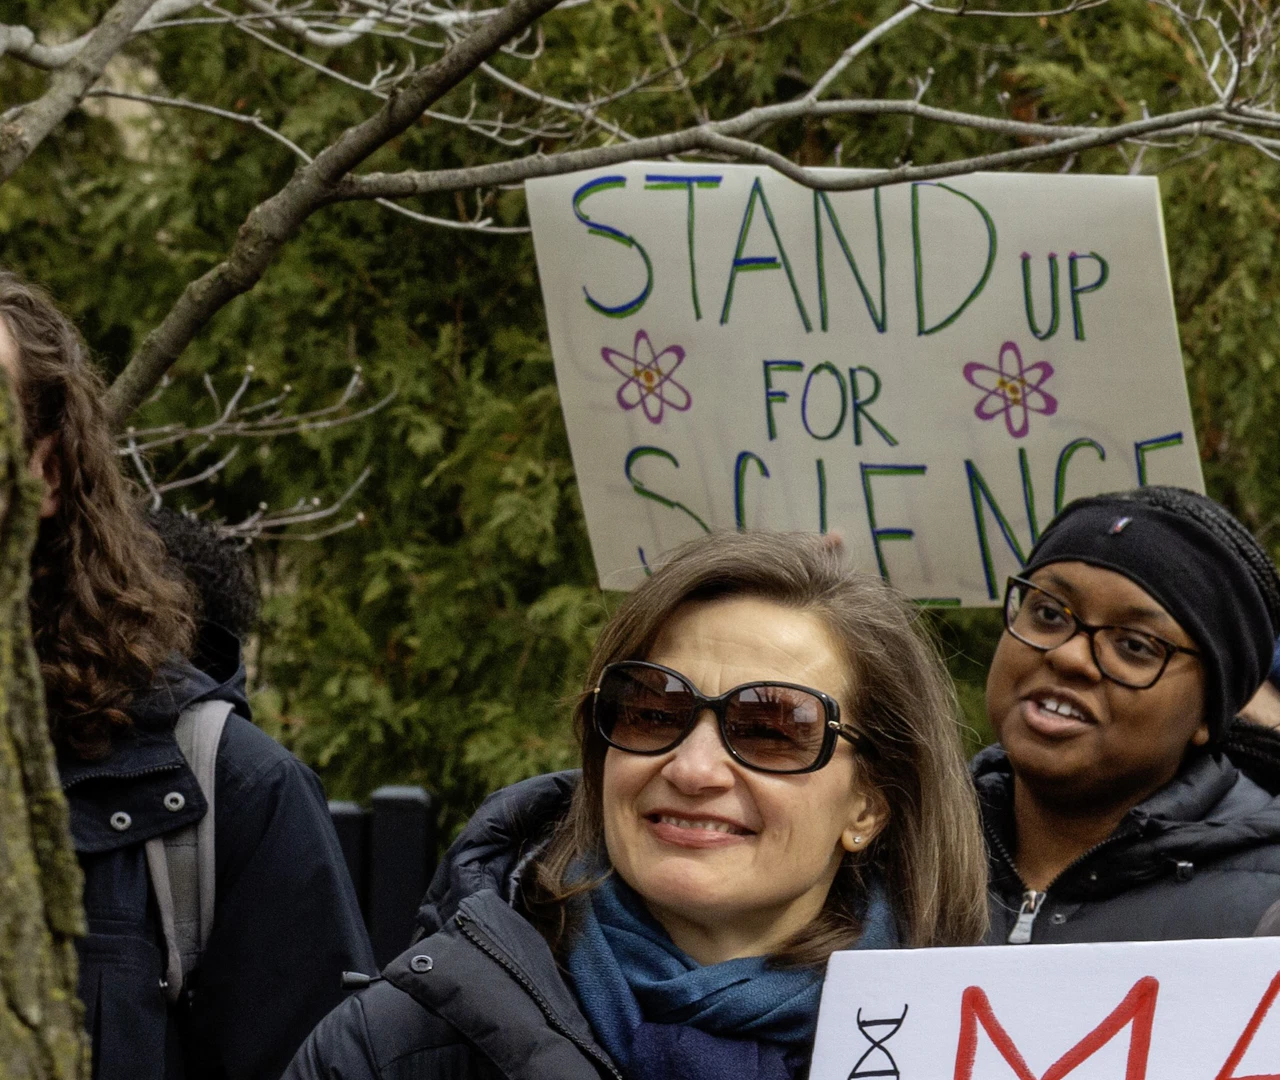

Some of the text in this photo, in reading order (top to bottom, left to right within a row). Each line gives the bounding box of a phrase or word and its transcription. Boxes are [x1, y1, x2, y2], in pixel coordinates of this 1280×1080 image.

[572, 174, 1110, 342] STAND UP
[762, 360, 899, 447] FOR
